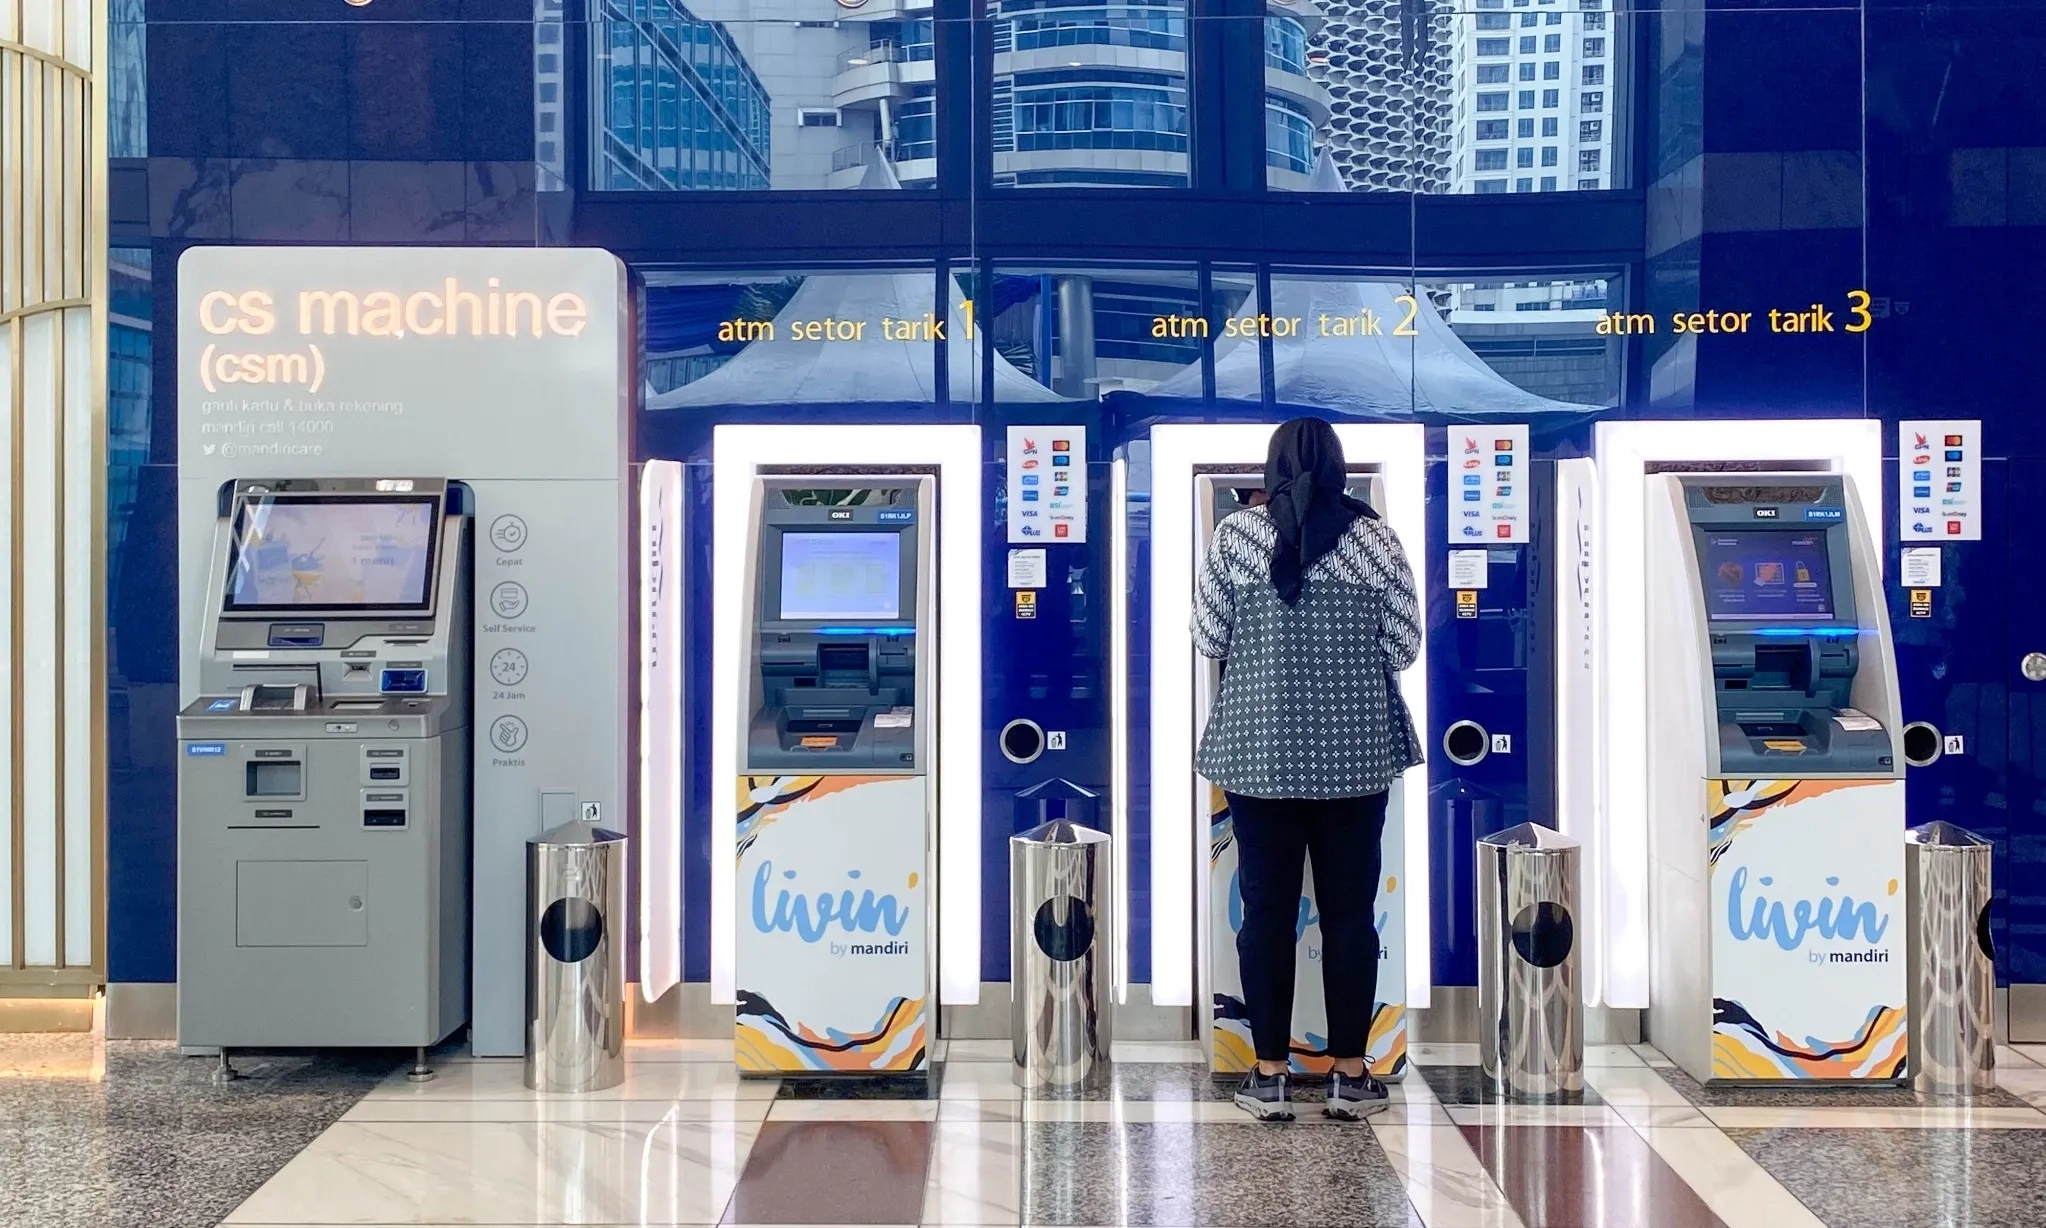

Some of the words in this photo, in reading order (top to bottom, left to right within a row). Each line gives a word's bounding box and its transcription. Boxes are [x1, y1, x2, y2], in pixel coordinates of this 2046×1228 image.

[200, 289, 275, 336] cs
[300, 277, 587, 338] machine
[1595, 310, 1655, 335] atm
[1672, 309, 1751, 334] setor
[1769, 304, 1834, 333] tarik
[1845, 290, 1872, 333] 3
[718, 317, 774, 342] atm
[791, 317, 866, 341] setor
[882, 313, 946, 342] tarik
[959, 300, 974, 341] 1
[1151, 314, 1209, 338] atm
[1225, 313, 1301, 338] setor
[1319, 307, 1383, 338] tarik
[1392, 295, 1418, 336] 2
[200, 343, 324, 392] (csm)
[242, 399, 279, 412] kartu
[283, 399, 294, 412] &
[299, 399, 335, 412] buka
[339, 399, 404, 415] rekening
[259, 420, 284, 434] call
[290, 420, 334, 434] 14000
[831, 511, 850, 519] OKI
[496, 558, 523, 567] Cepat
[483, 624, 501, 633] Self
[502, 624, 536, 633] Service
[502, 663, 516, 672] 24
[492, 691, 504, 700] 24
[506, 691, 526, 700] Jam
[492, 758, 526, 767] Praktis
[830, 941, 848, 959] by
[851, 941, 908, 955] mandiri
[1809, 950, 1826, 966] by
[1829, 949, 1888, 963] mandiri
